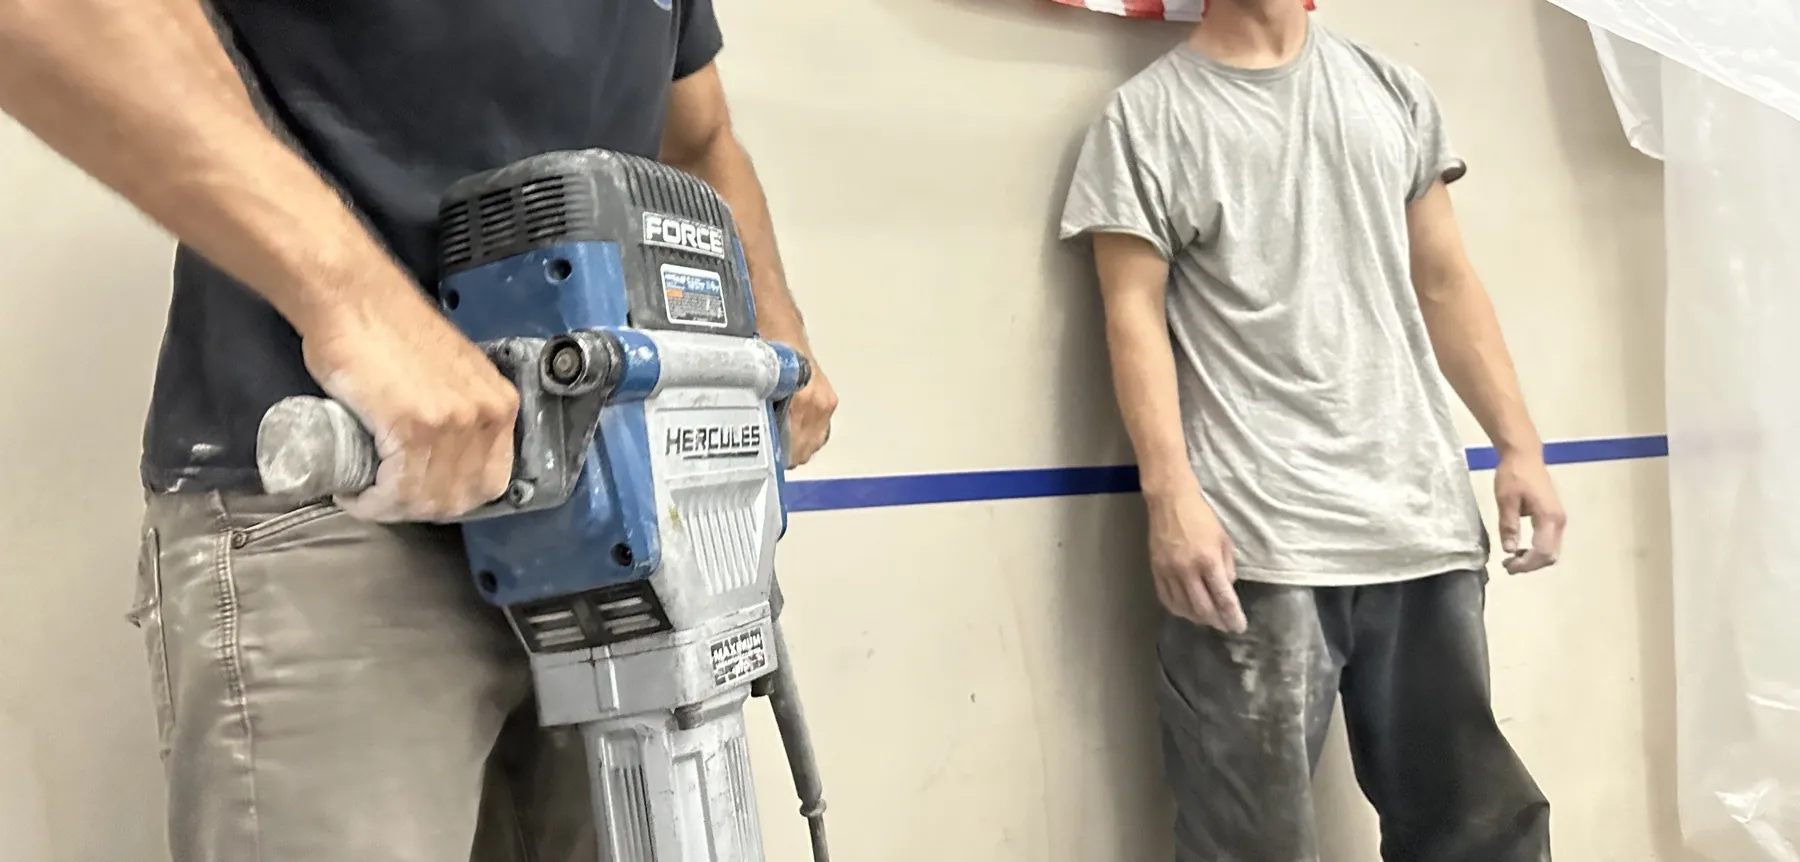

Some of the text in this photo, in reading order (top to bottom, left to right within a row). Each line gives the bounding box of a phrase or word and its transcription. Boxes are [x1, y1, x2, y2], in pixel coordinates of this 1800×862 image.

[646, 217, 723, 254] FORCE
[665, 426, 760, 455] HERCULES
[713, 633, 761, 662] MAXIMUM
